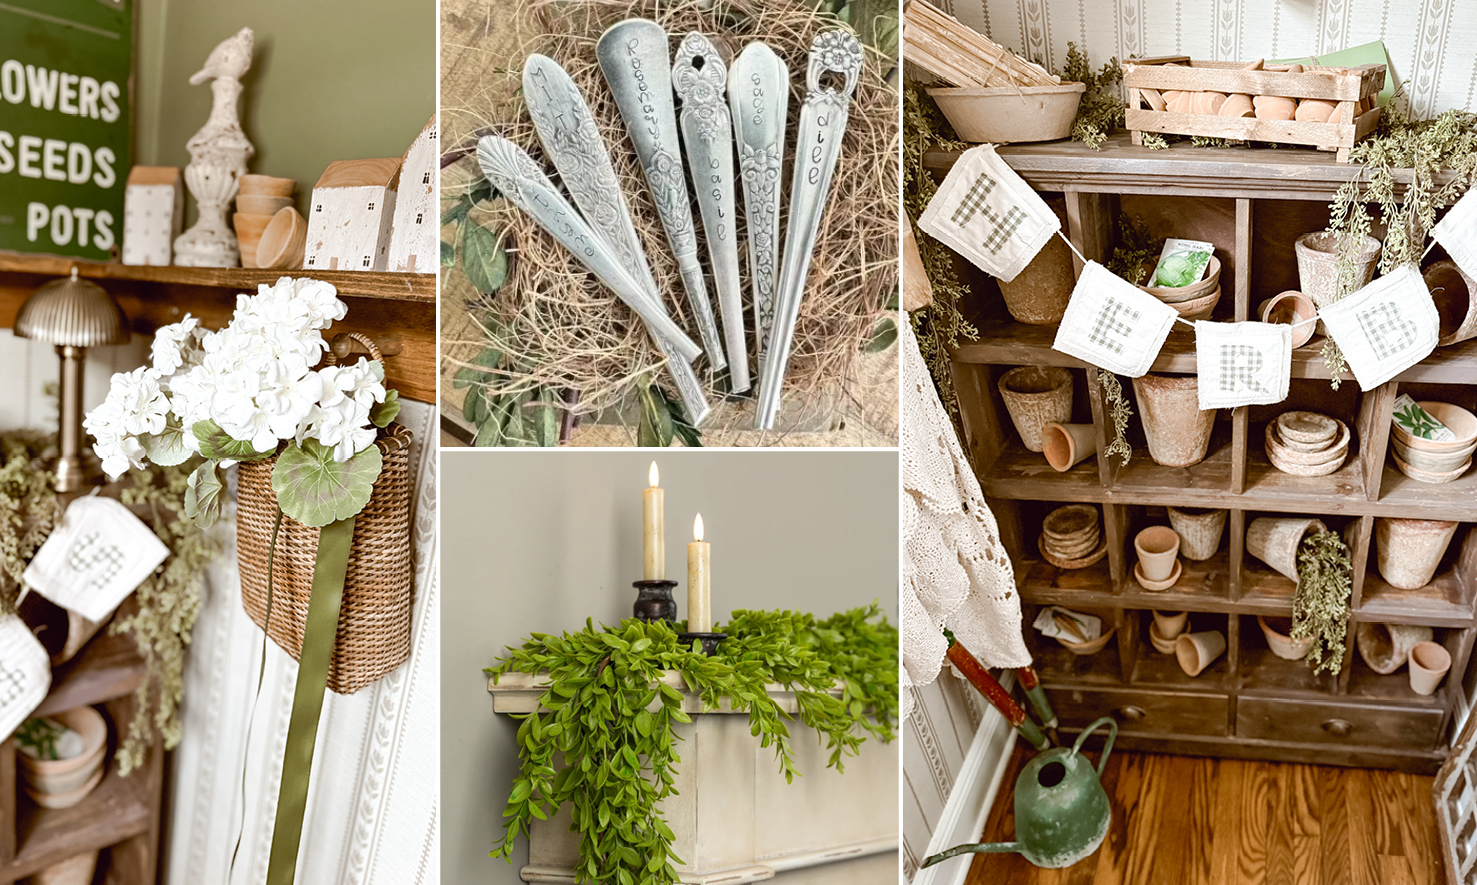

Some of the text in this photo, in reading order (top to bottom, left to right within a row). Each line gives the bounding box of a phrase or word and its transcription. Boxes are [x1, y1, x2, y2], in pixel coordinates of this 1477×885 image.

[0, 59, 120, 123] OWERS
[530, 67, 567, 131] MINT
[626, 38, 660, 140] Rosemary
[751, 73, 765, 126] sage
[0, 131, 116, 189] SEEDS
[809, 112, 830, 185] dill
[27, 201, 115, 251] POTS
[708, 156, 727, 241] basil
